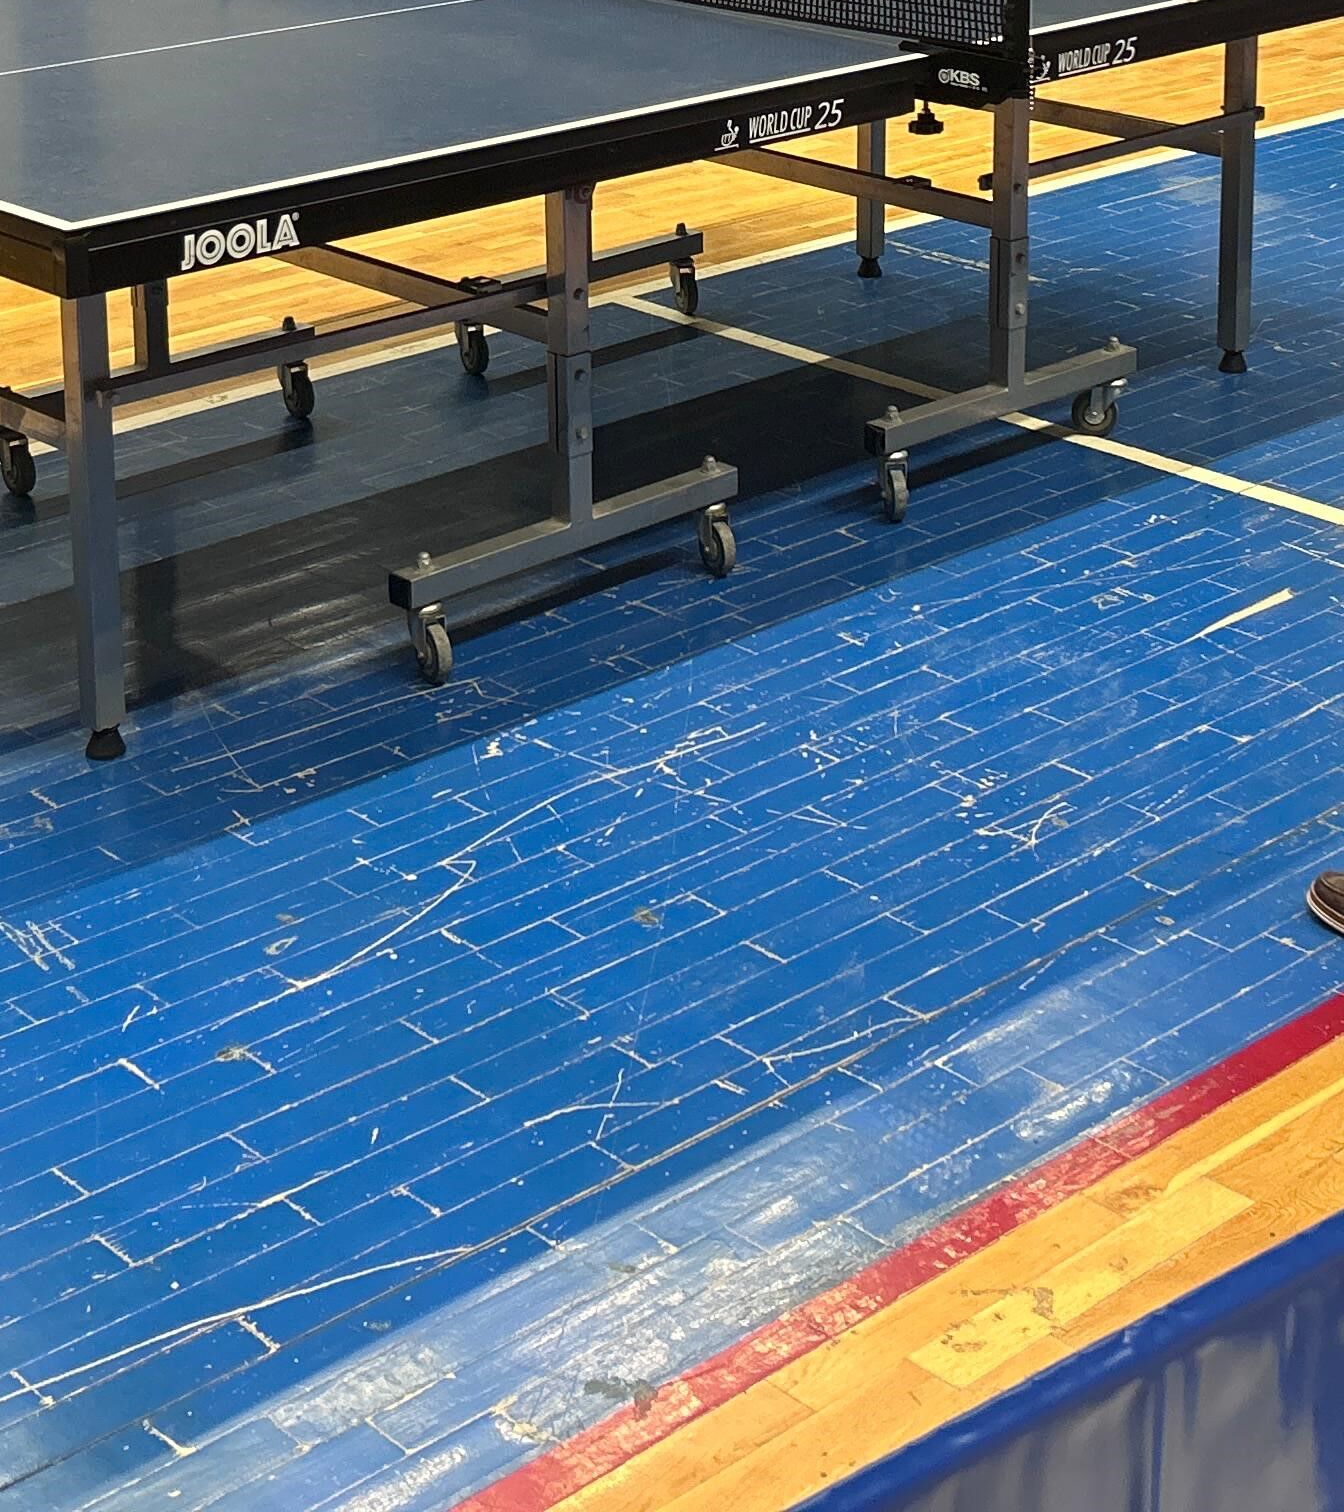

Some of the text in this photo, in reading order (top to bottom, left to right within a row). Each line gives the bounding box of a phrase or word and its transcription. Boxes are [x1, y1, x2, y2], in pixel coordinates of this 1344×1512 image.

[1058, 37, 1137, 73] WORLD CUP 25
[951, 70, 980, 86] KBS
[749, 98, 845, 140] WORLD CUP 25
[180, 213, 299, 271] JOOLA
